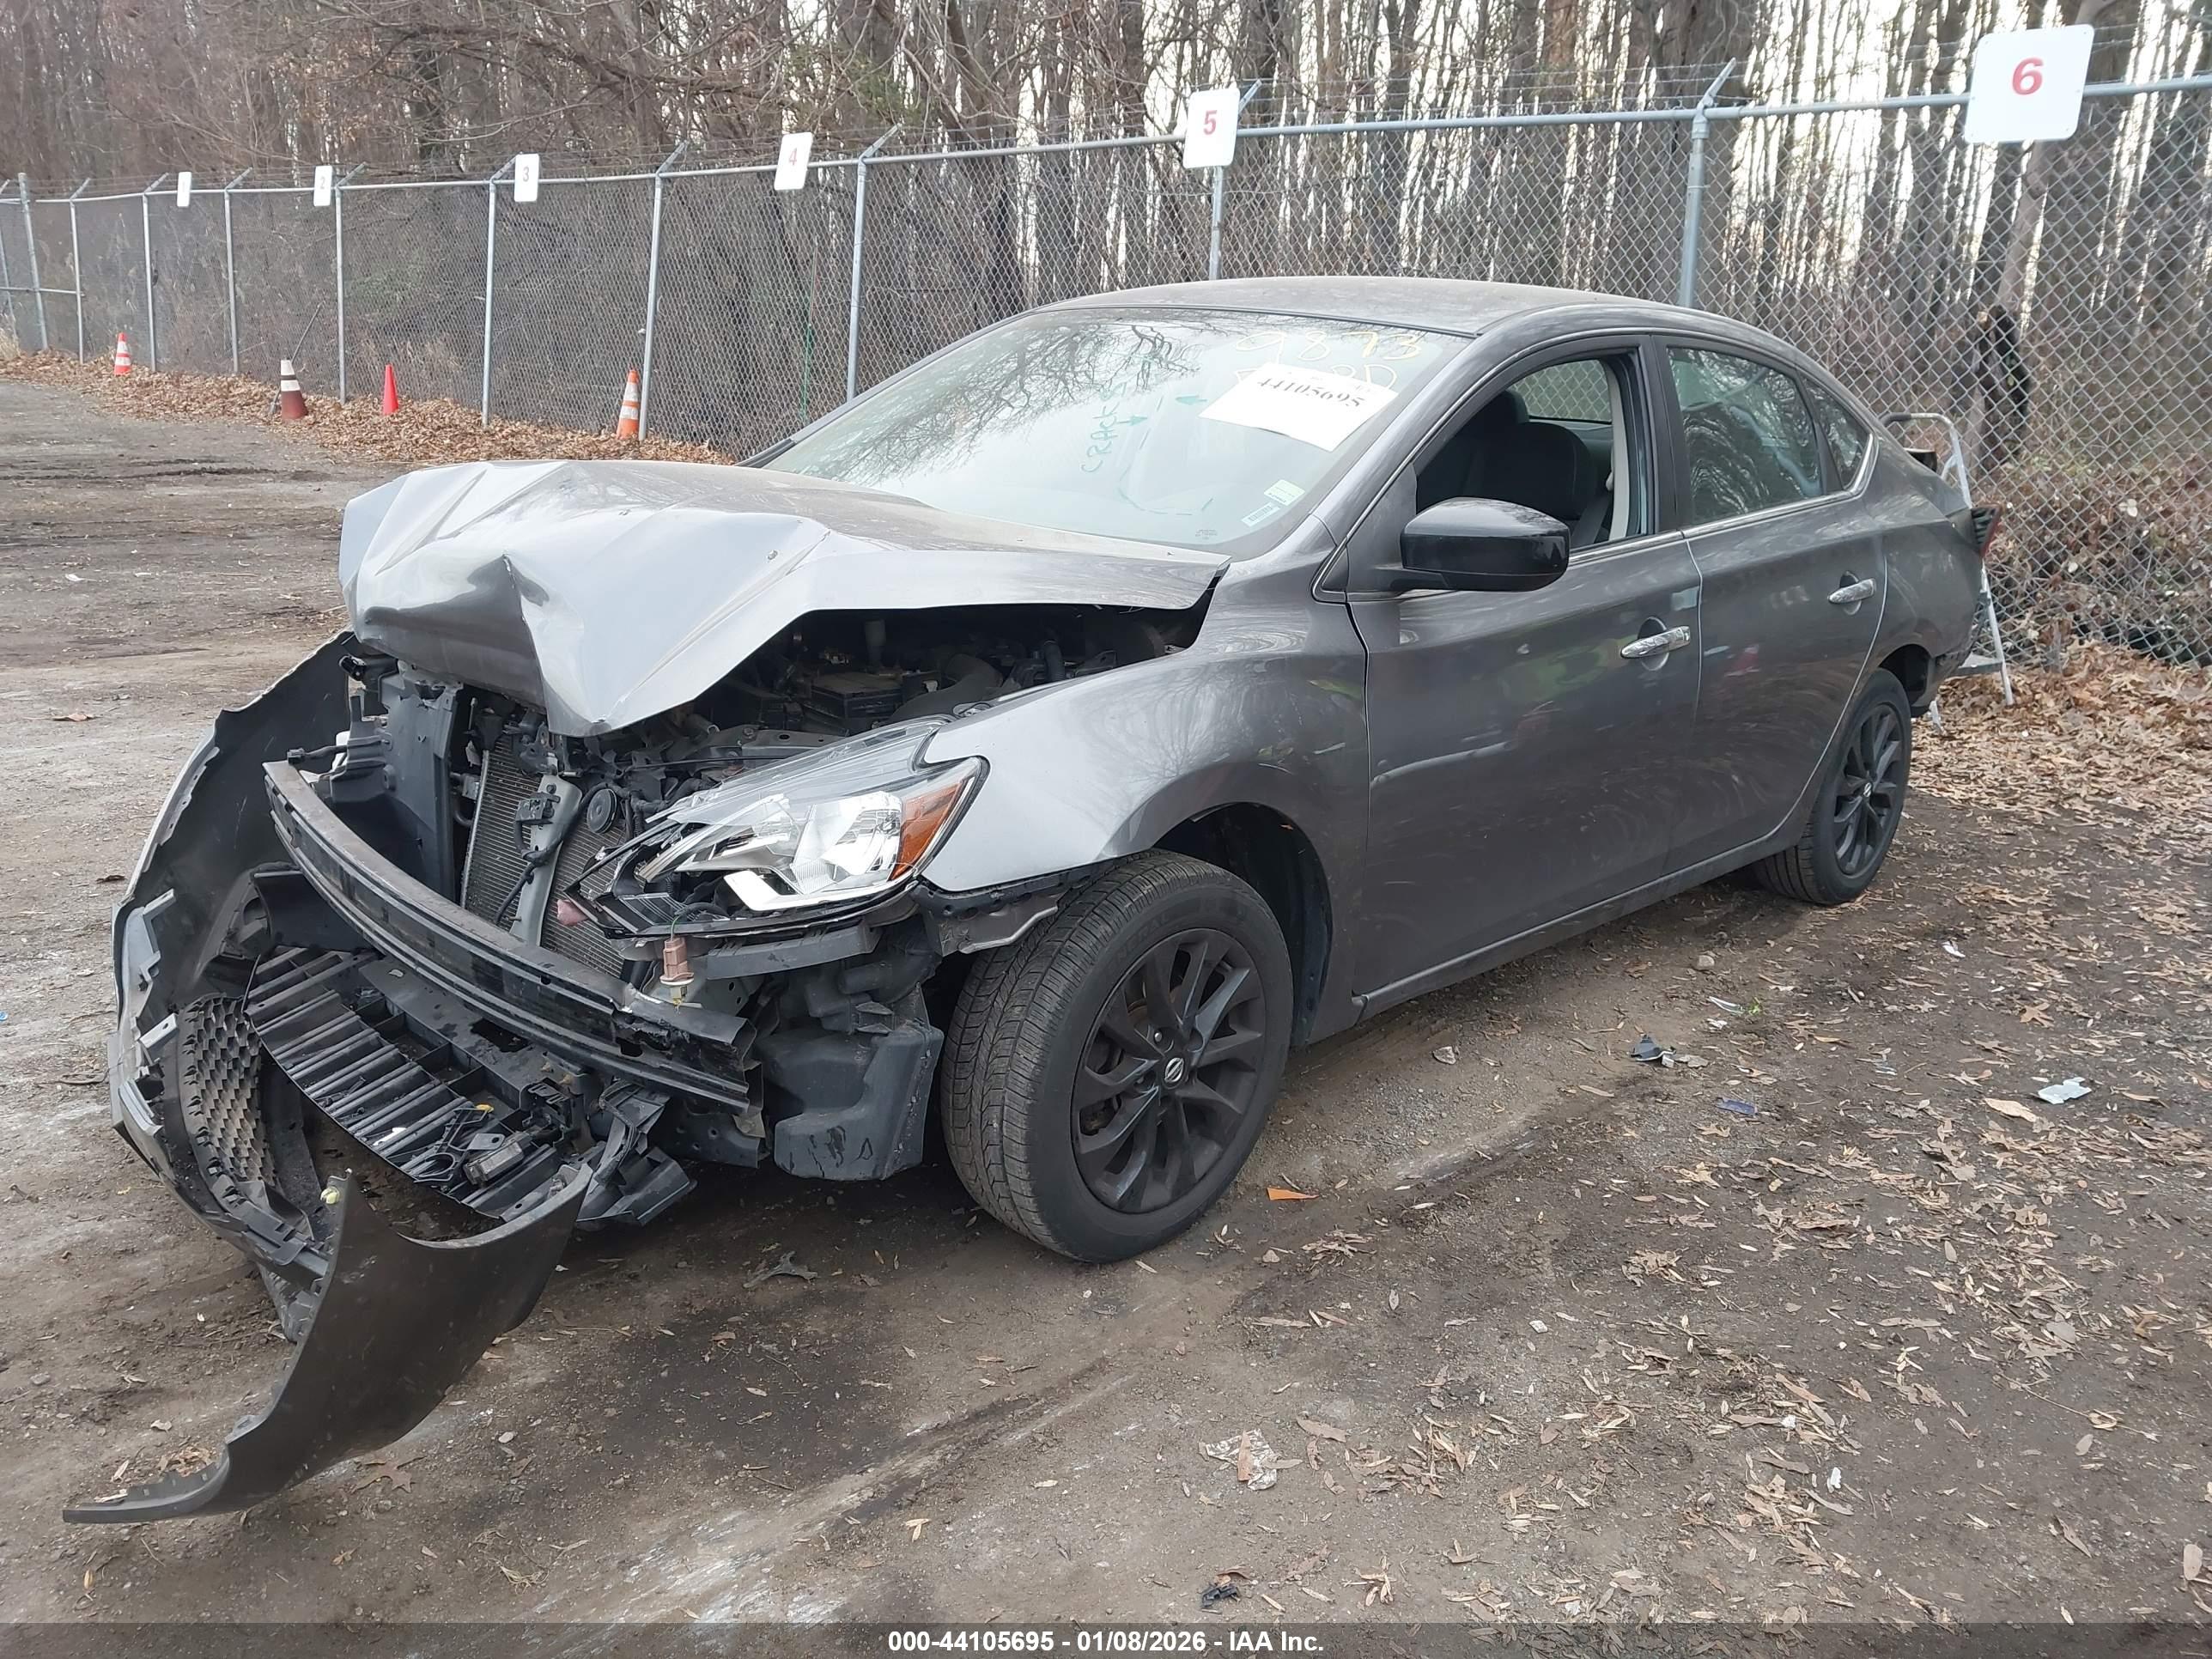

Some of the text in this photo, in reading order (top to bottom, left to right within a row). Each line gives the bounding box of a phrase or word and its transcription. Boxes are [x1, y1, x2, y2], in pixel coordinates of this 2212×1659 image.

[2012, 57, 2045, 96] 6
[1203, 109, 1218, 136] 5
[788, 147, 798, 166] 4
[319, 175, 325, 190] 2
[523, 166, 530, 182] 3
[1236, 330, 1422, 364] 9873
[1257, 376, 1366, 408] 44105695
